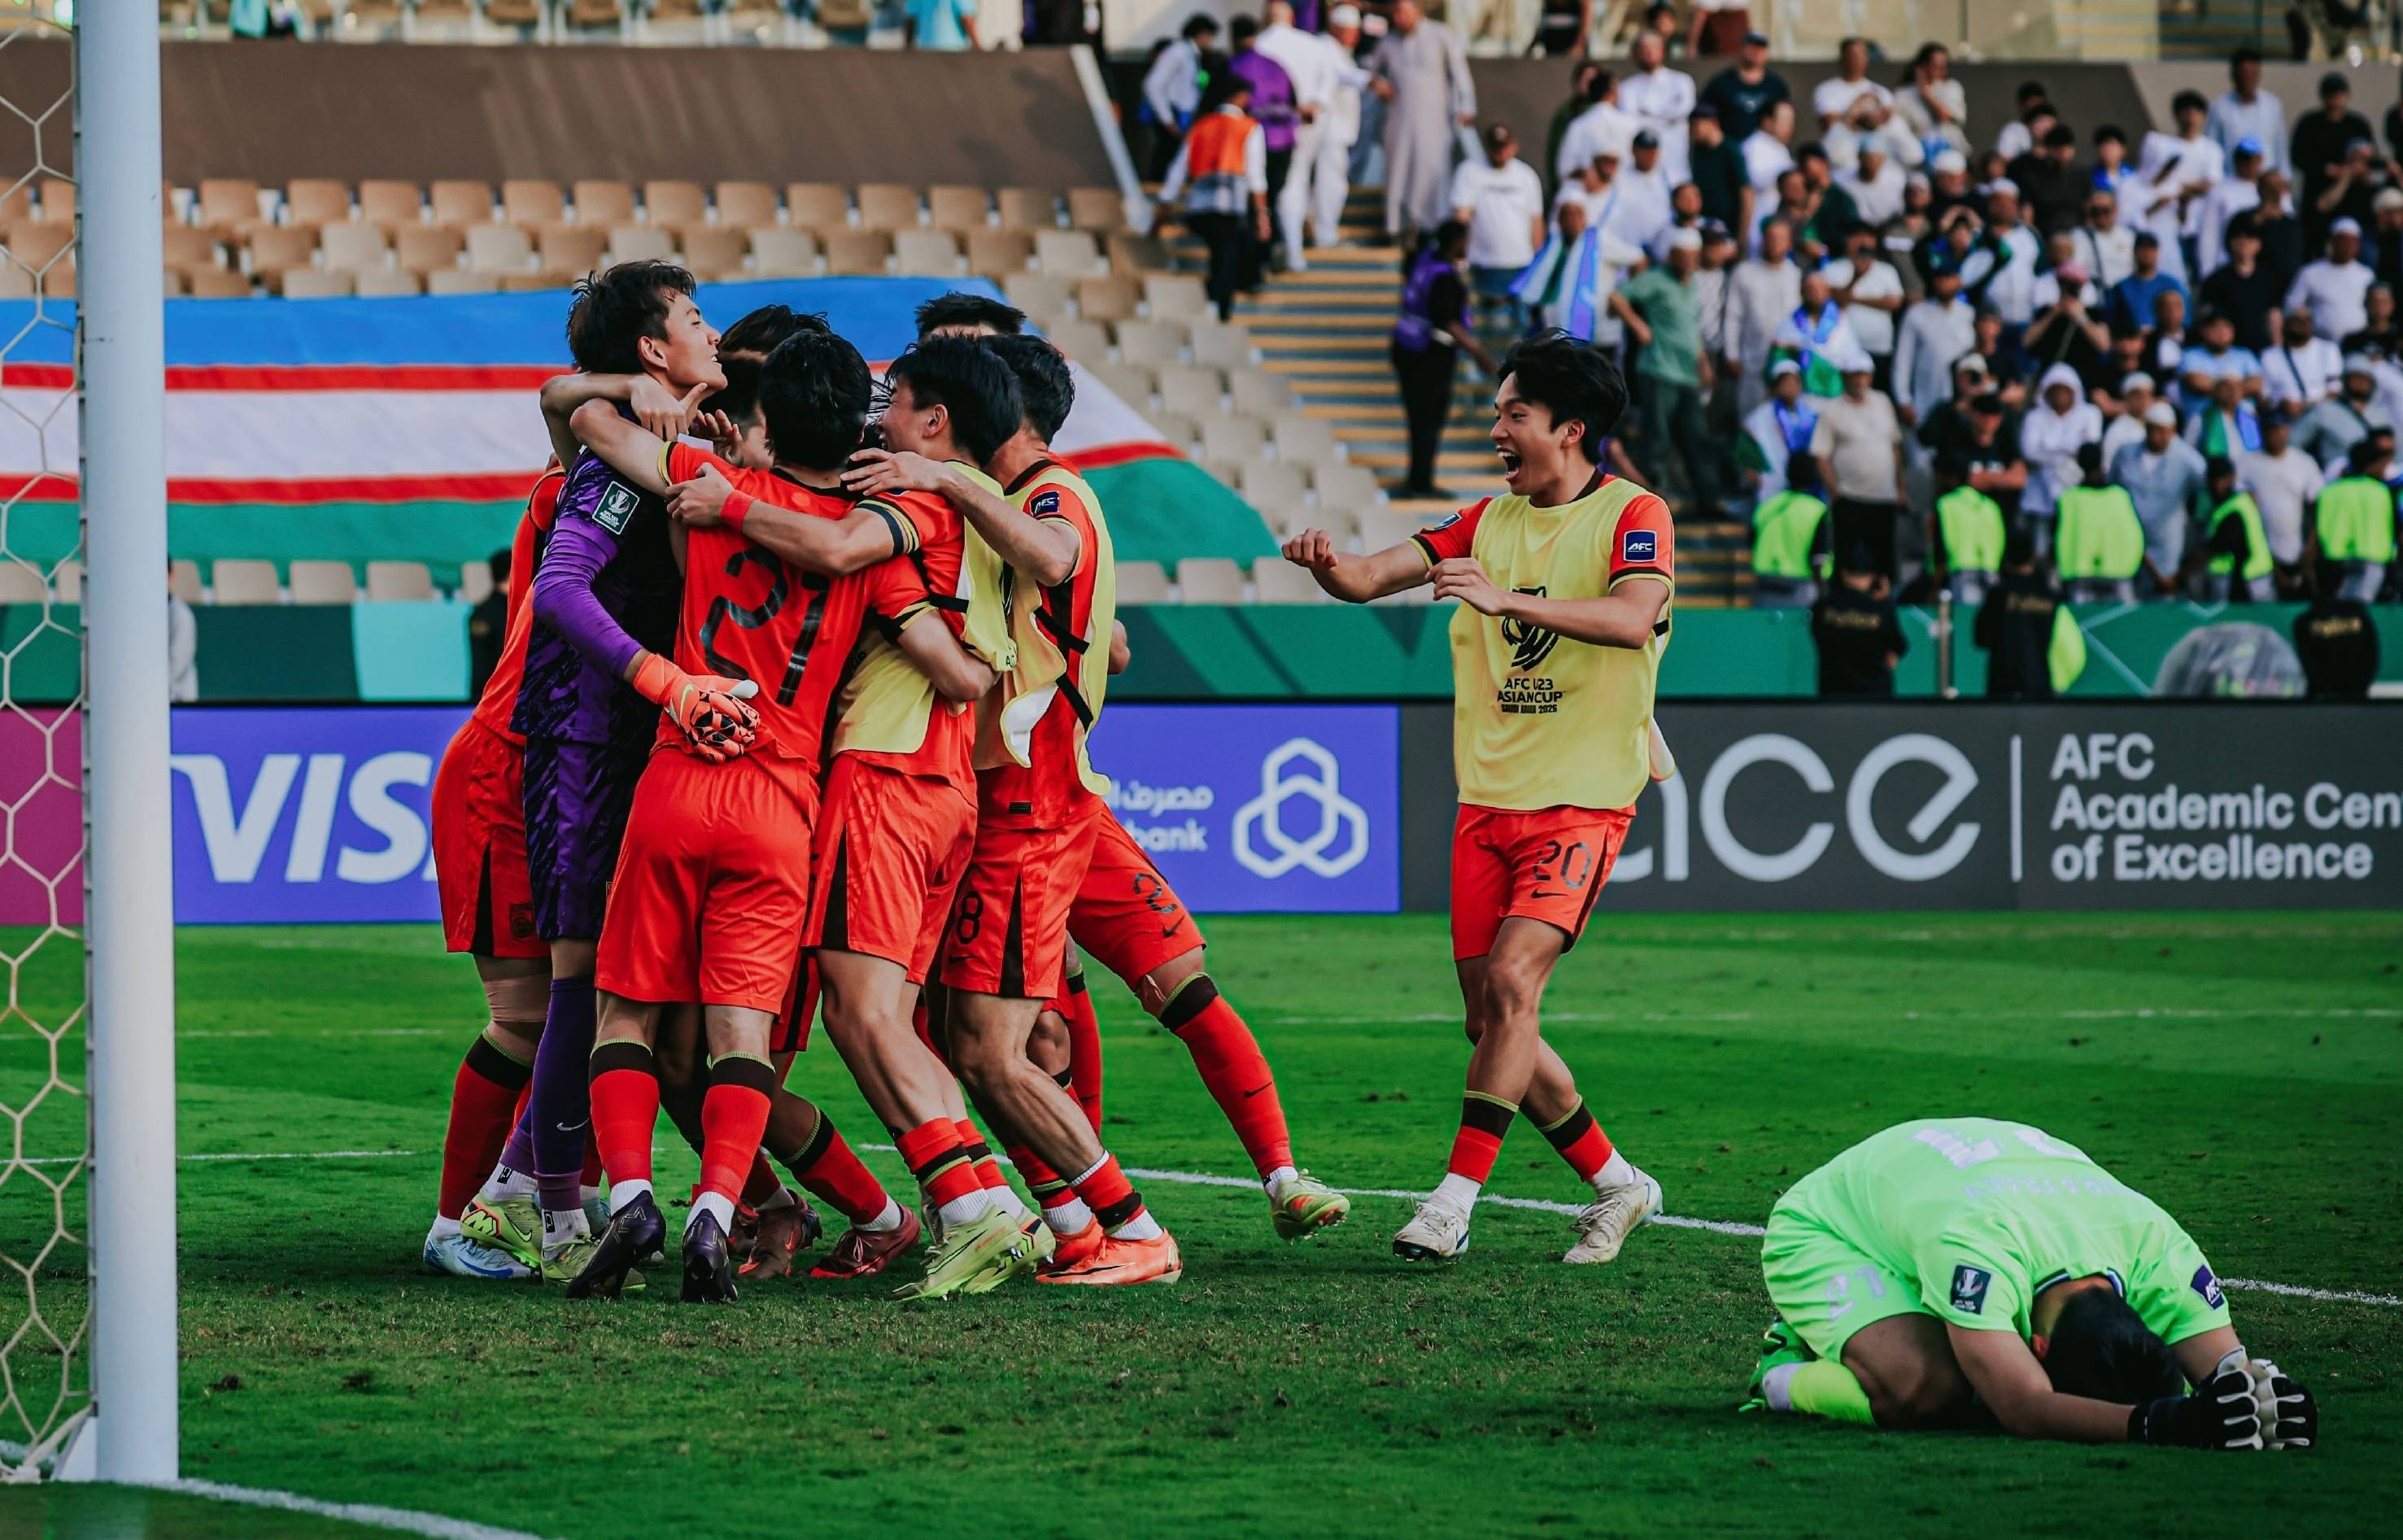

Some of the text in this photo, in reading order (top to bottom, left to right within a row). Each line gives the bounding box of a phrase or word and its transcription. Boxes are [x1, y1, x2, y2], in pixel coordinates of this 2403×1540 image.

[1034, 497, 1056, 513] AFC
[1627, 543, 1653, 551] AFC
[700, 543, 831, 707] 21
[1504, 678, 1530, 690] AFC
[2051, 732, 2154, 779] AFC
[169, 752, 438, 883] VIS
[2051, 782, 2403, 830] Academic Cen
[1533, 839, 1591, 888] 20
[2052, 834, 2373, 881] of Excellence
[956, 890, 983, 944] 8
[1133, 873, 1177, 914] 2
